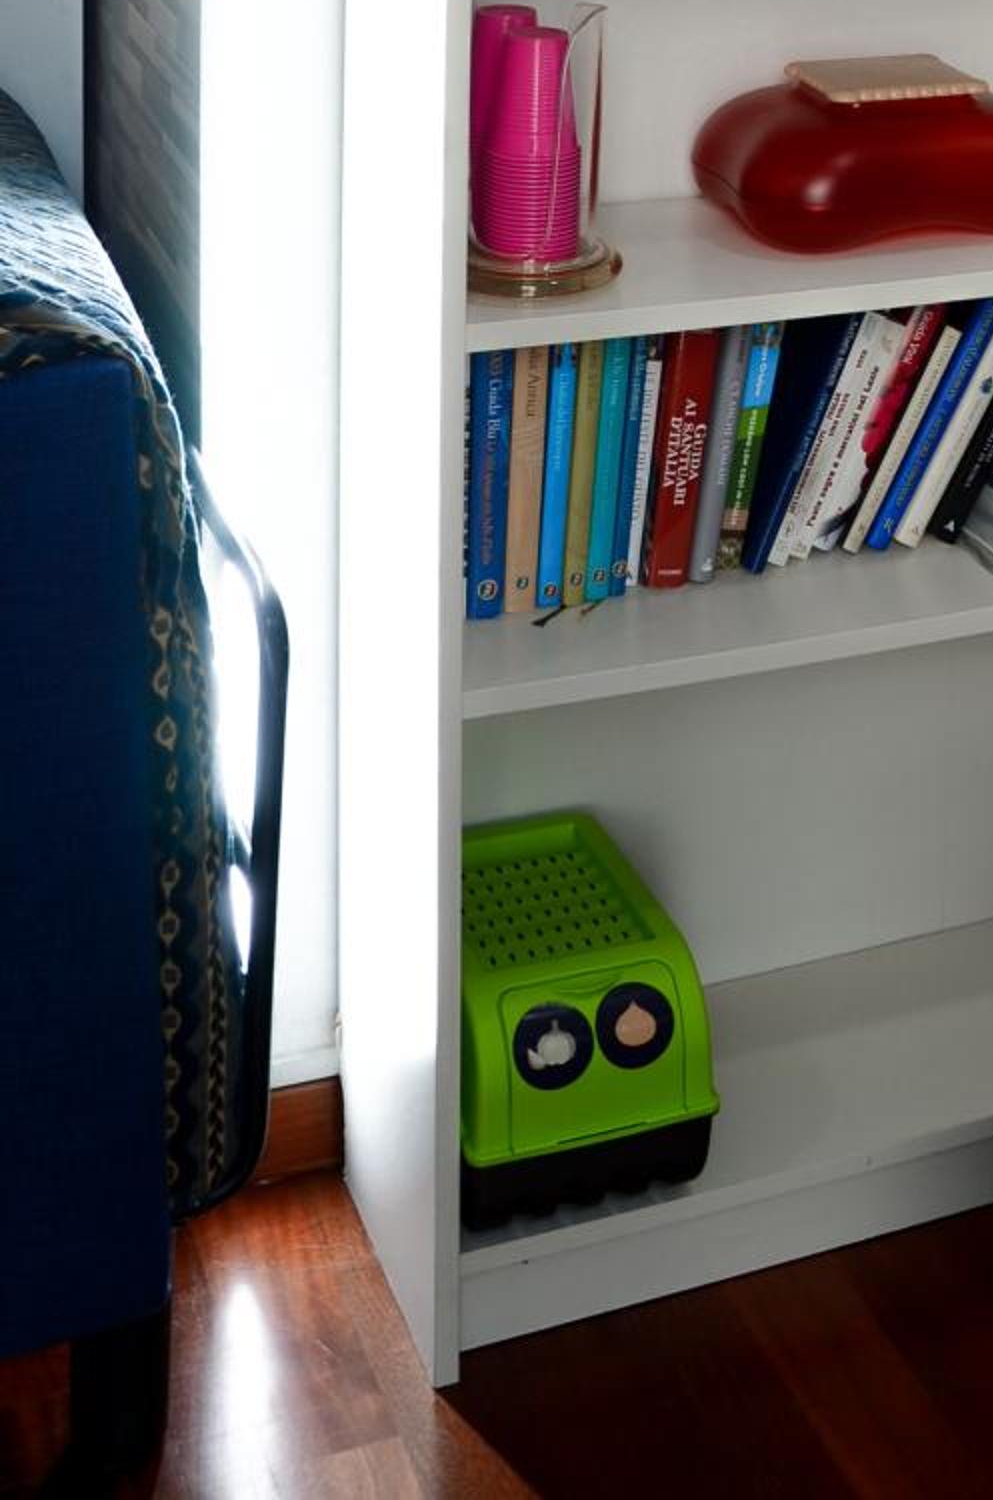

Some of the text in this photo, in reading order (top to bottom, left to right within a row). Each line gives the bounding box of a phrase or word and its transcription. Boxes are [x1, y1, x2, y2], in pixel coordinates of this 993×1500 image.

[663, 417, 683, 488] D'ITALIA
[673, 398, 697, 506] AI SANTUARI
[688, 423, 707, 481] GUIDA
